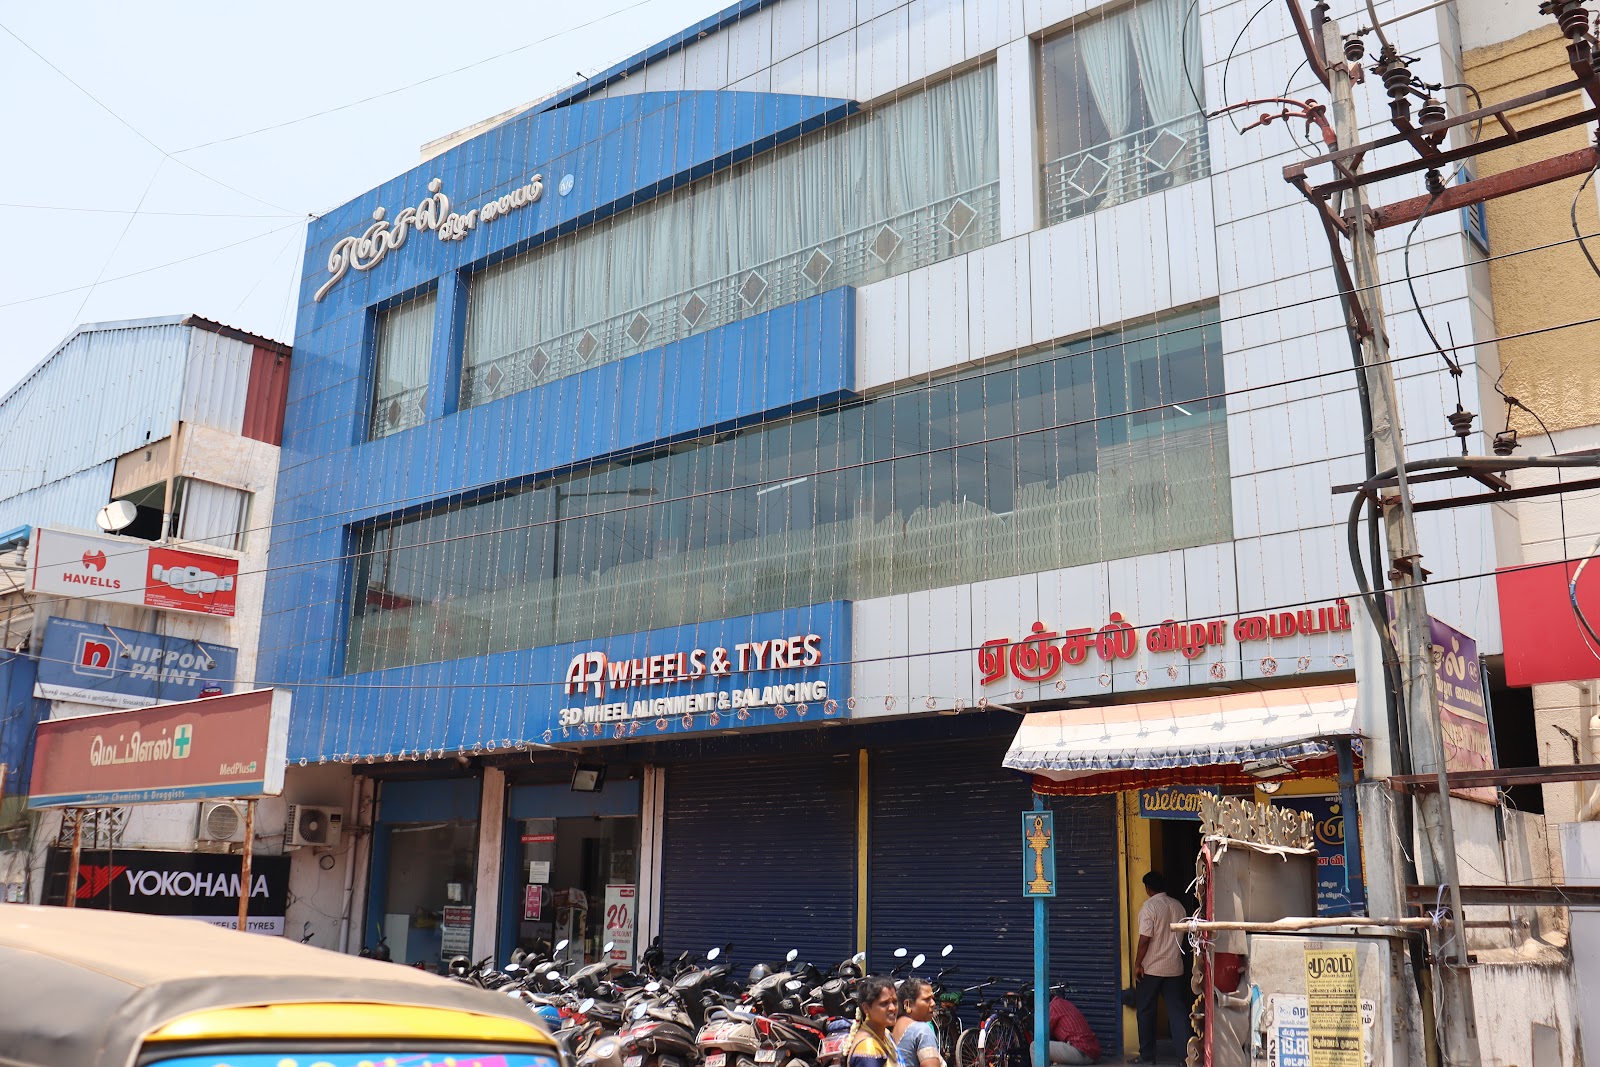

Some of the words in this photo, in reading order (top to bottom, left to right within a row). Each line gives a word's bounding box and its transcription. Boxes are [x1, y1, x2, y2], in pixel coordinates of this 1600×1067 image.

[313, 177, 449, 302] ஏஞ்சல்
[438, 209, 480, 242] விழா
[480, 173, 544, 223] மையம்
[63, 572, 121, 590] HAVELLS
[978, 611, 1138, 686] ஏஞ்சல்
[1146, 618, 1227, 660] விழா
[1232, 598, 1353, 643] மையம்
[126, 643, 210, 672] NIPPON
[607, 649, 706, 690] WHEELS
[710, 647, 732, 677] &
[735, 633, 822, 671] TYRES
[130, 663, 201, 687] PAINT
[559, 707, 584, 726] 3D
[583, 701, 632, 724] WHEEL
[631, 692, 718, 719] ALIGNMENT
[717, 690, 731, 711] &
[731, 680, 828, 709] BALANCING
[90, 728, 172, 767] மெட்பிளஸ்
[219, 763, 250, 776] MedPlus
[111, 791, 141, 802] Chemists
[151, 789, 185, 800] Druggists
[125, 869, 270, 898] YOKOHAMA
[248, 921, 275, 930] TYRES
[1308, 953, 1353, 979] மூலம்
